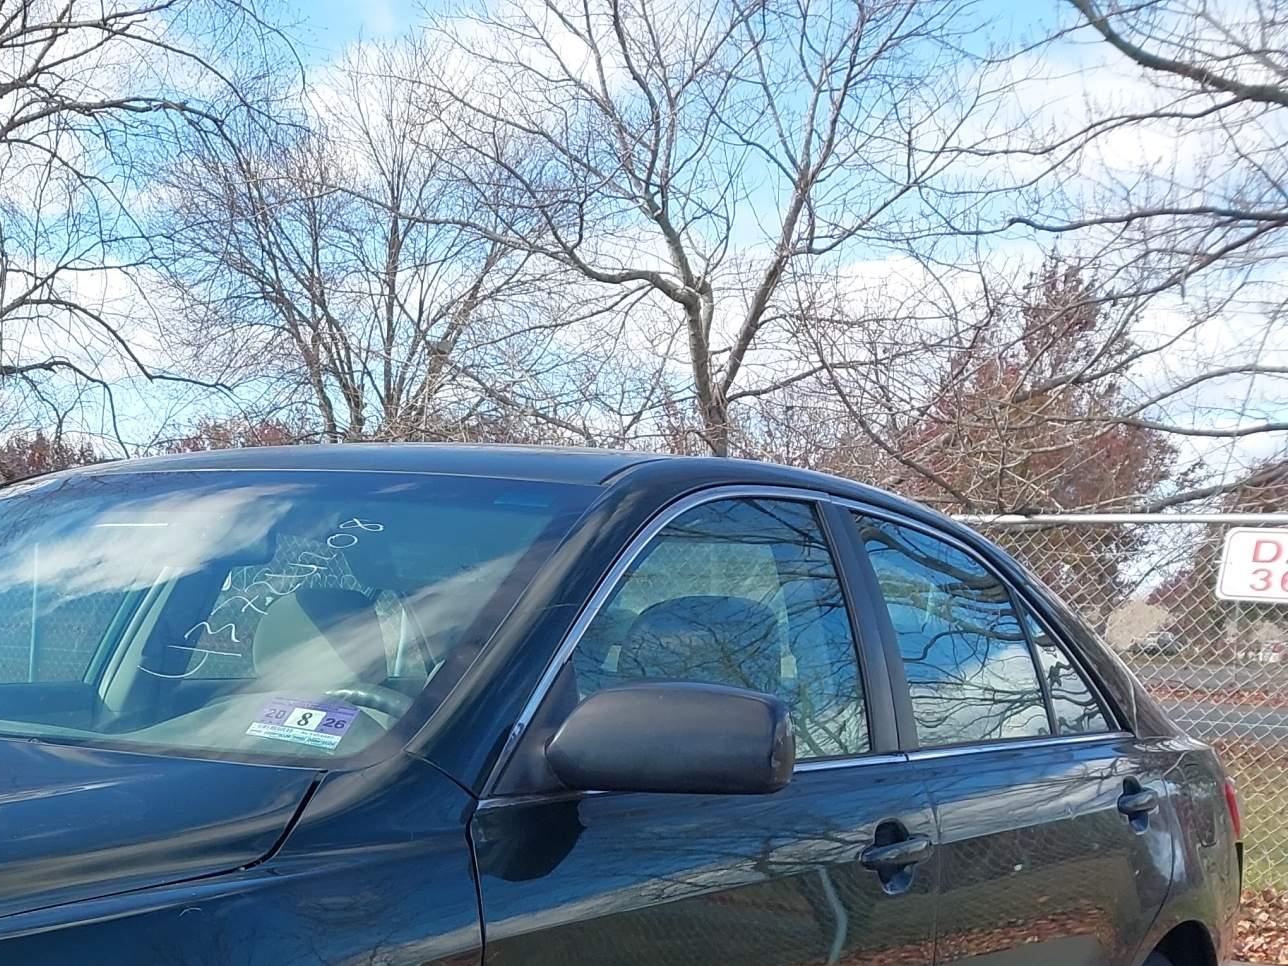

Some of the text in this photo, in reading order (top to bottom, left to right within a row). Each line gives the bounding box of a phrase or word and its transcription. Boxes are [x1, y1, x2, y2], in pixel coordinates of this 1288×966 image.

[1252, 539, 1288, 564] D
[265, 708, 348, 729] 20 8 26
